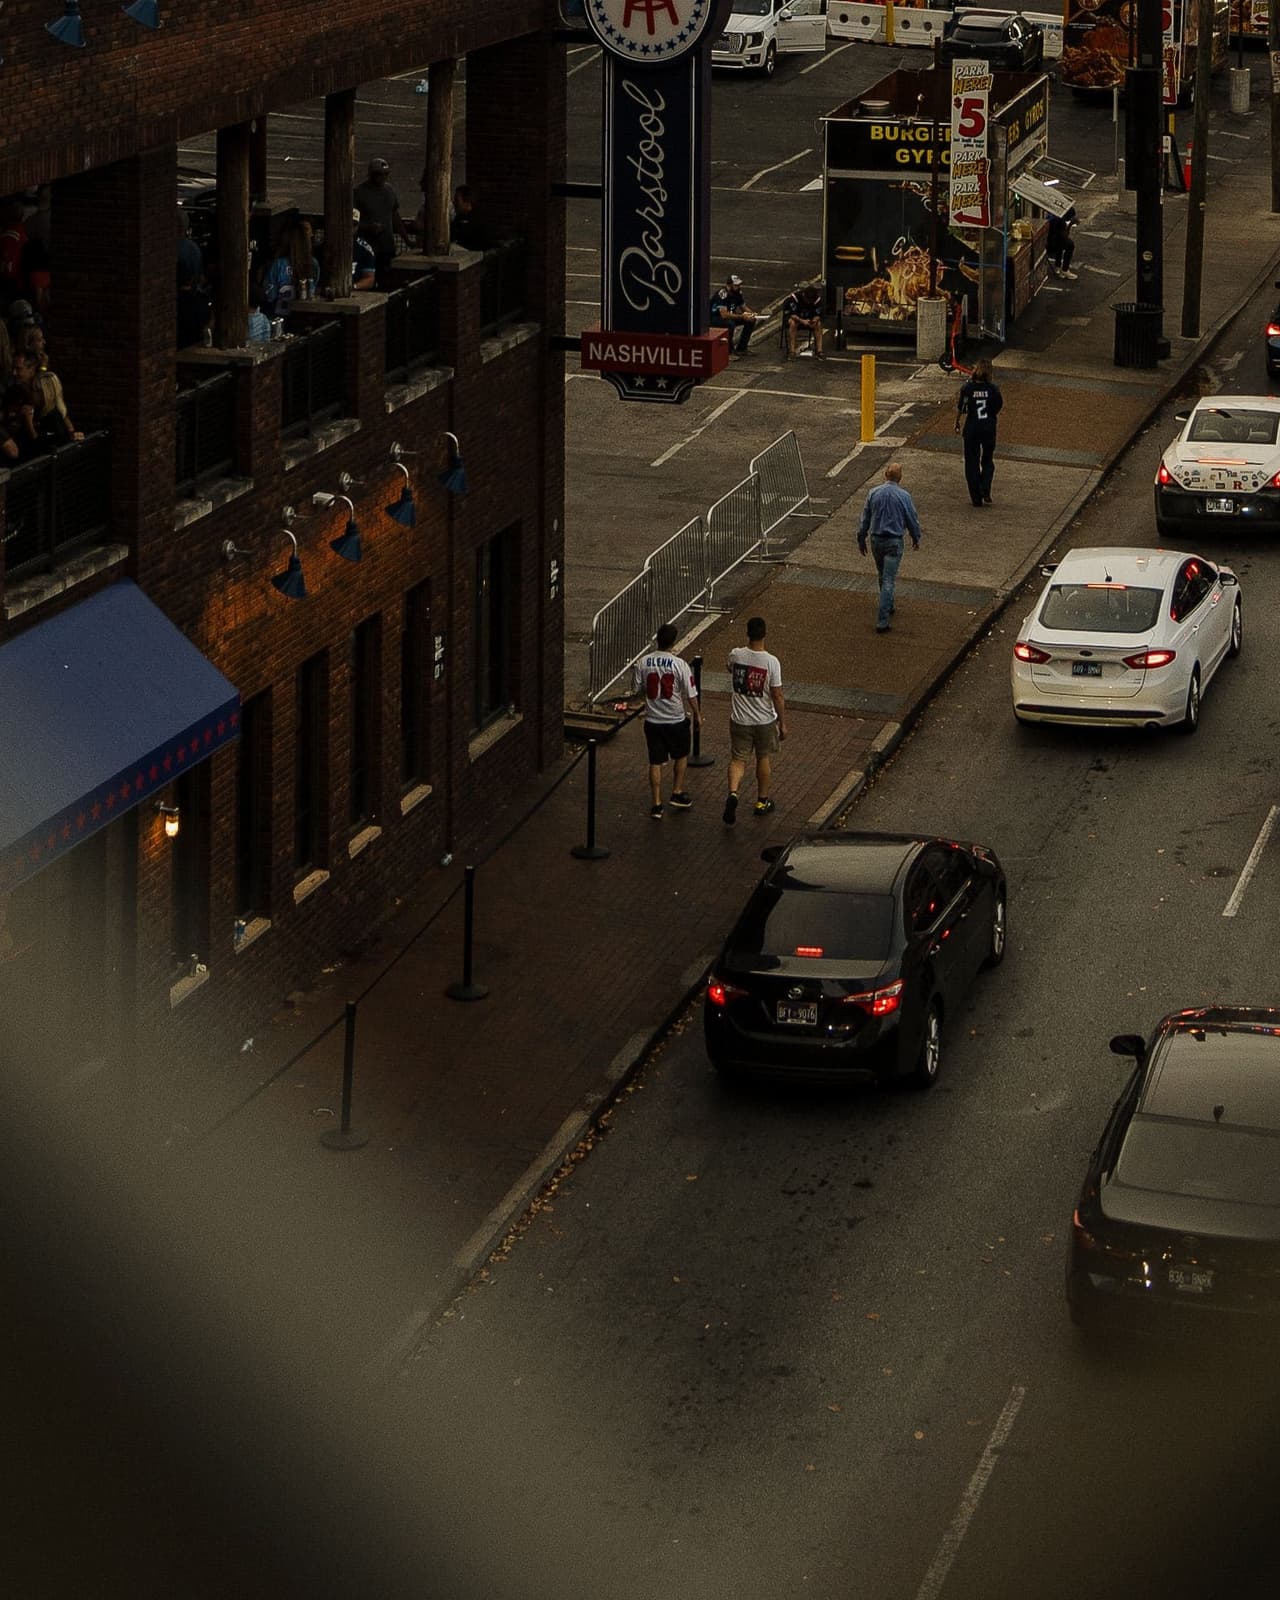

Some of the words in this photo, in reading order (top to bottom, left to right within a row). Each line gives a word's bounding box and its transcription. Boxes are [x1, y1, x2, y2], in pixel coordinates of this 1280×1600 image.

[955, 65, 985, 79] PARK
[953, 75, 992, 95] HERE!
[1025, 100, 1044, 130] GYROS
[954, 151, 982, 163] PARK
[952, 160, 990, 179] HERE!
[620, 79, 683, 312] Barstool
[953, 182, 981, 195] PARK
[951, 194, 989, 211] HERE!
[589, 341, 704, 369] NASHVILLE
[976, 399, 988, 419] 2
[646, 657, 673, 668] GLENN
